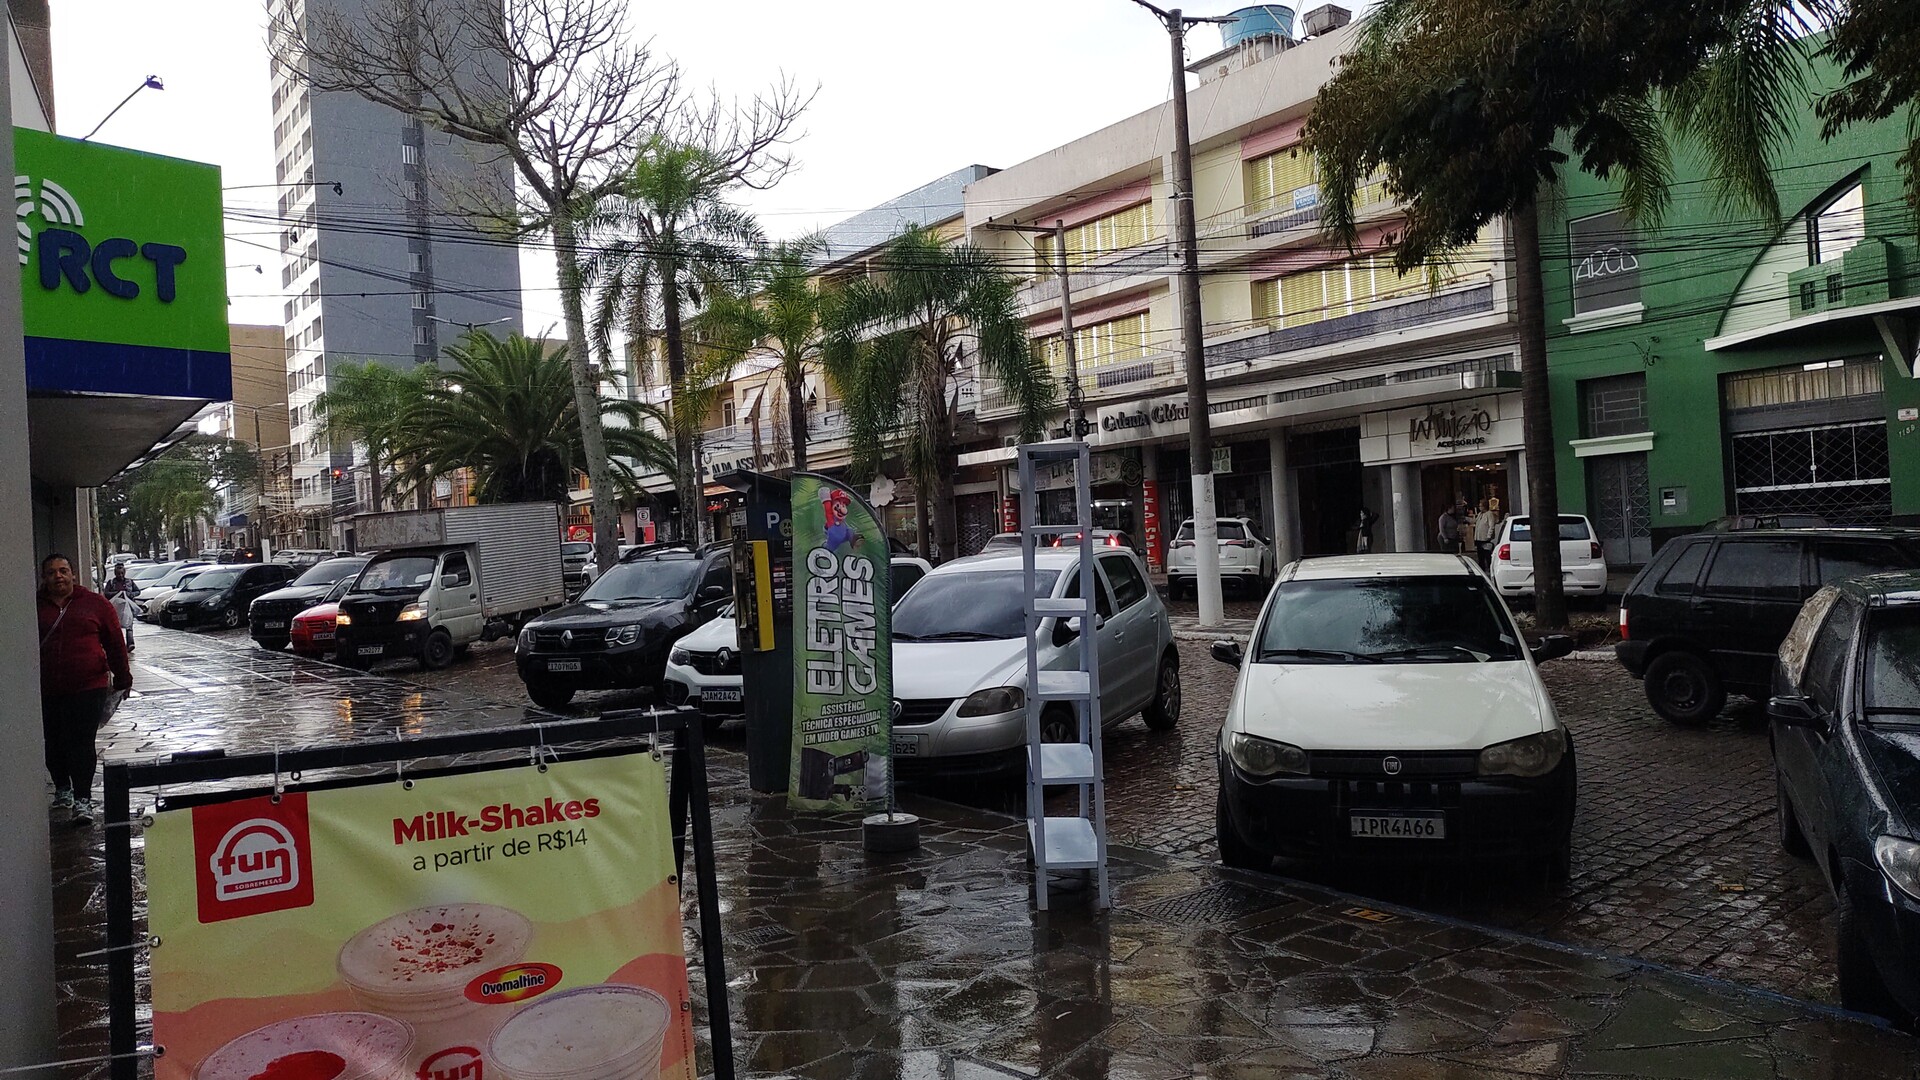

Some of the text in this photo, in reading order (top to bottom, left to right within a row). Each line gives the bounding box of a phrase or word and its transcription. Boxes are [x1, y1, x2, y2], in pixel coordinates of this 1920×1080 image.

[38, 228, 187, 303] RCT
[766, 512, 780, 529] P
[806, 547, 844, 695] ELETRO
[842, 555, 877, 694] GAMES
[802, 720, 833, 732] TÉCNICA
[805, 734, 816, 744] EM
[817, 731, 840, 743] VIDEO
[840, 727, 866, 740] GAMES
[393, 797, 600, 845] Milk-Shakes
[1358, 818, 1435, 836] IPR4A66
[218, 829, 293, 883] fun
[412, 828, 588, 872] a partir de R$14
[234, 877, 282, 891] SOBREMESAS
[482, 974, 544, 996] Ovomaltine
